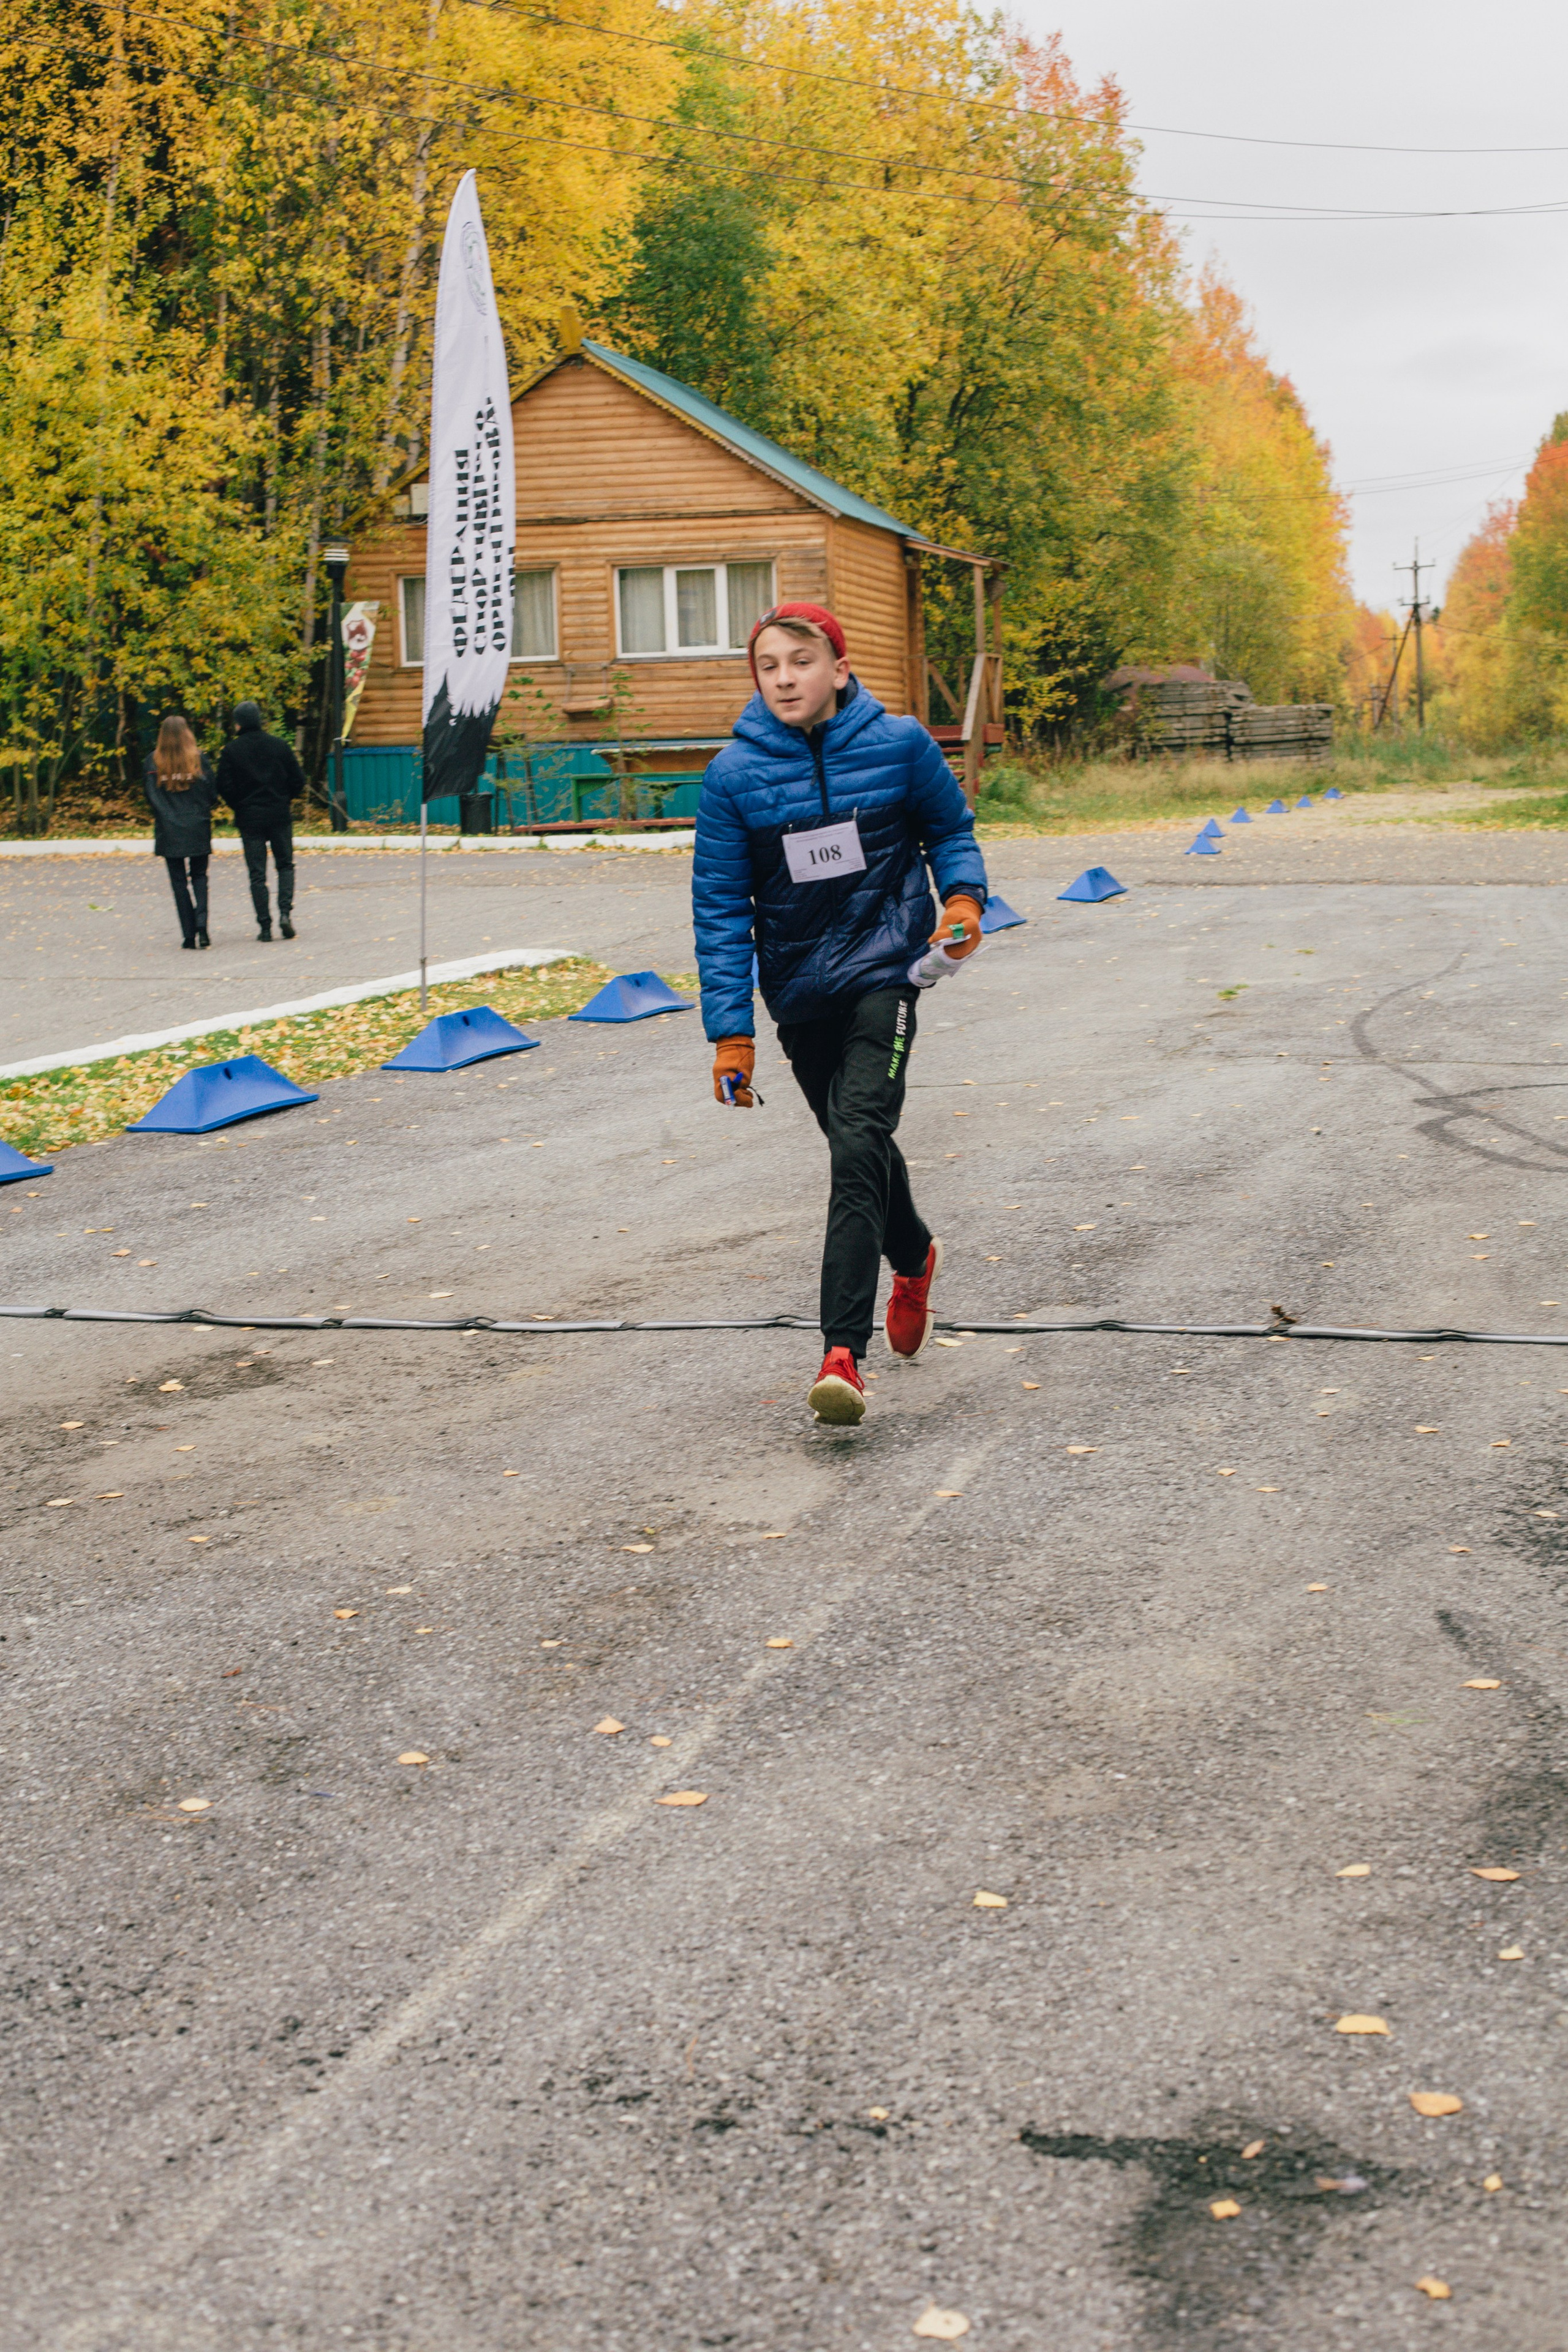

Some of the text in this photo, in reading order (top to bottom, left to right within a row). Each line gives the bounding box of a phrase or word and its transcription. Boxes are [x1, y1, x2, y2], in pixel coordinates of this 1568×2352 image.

[449, 449, 470, 658] ФЕДЕРАЦИЯ
[808, 844, 842, 865] 108
[888, 1000, 908, 1079] MAKE THE FUTURE
